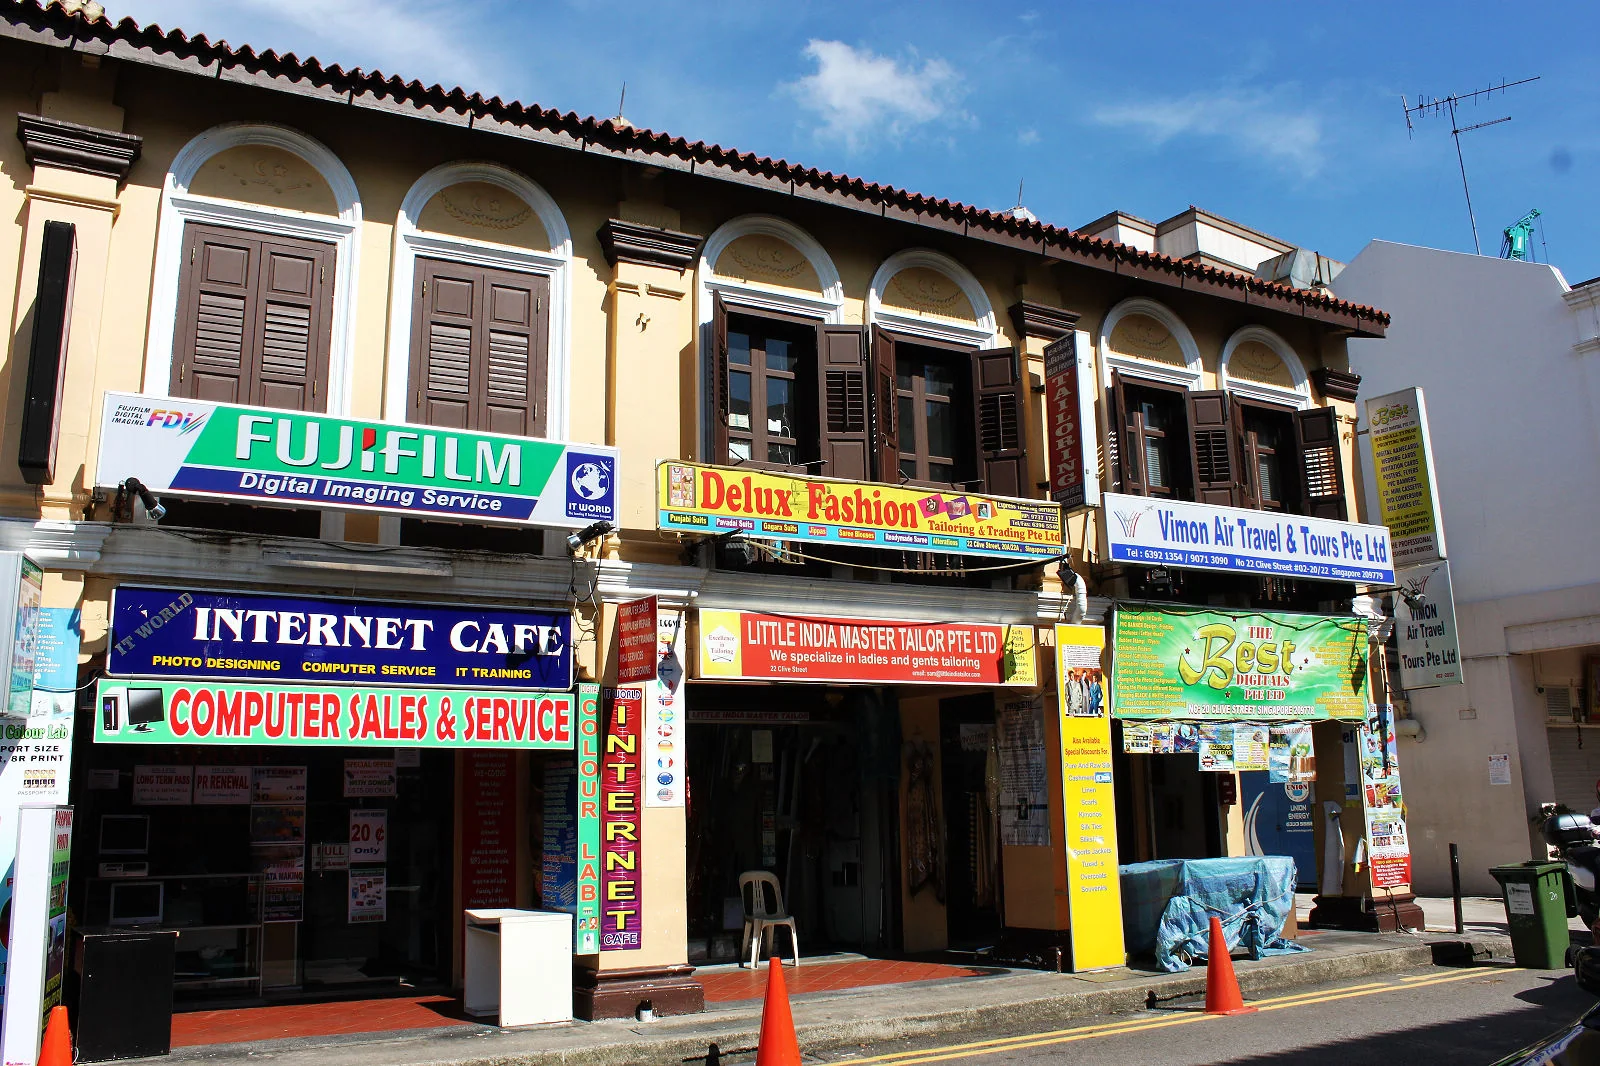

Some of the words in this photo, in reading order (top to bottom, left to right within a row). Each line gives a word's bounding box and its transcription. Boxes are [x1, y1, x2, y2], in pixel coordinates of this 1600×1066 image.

[115, 411, 142, 419] DIGITAL
[118, 404, 151, 413] FUJIFILM
[112, 418, 144, 426] IMAGING
[146, 408, 194, 428] FDi
[1052, 371, 1077, 487] TAILORING
[235, 414, 522, 487] FUJIFILM
[1402, 451, 1416, 459] CARDS
[1381, 463, 1403, 472] INVITATION
[1404, 459, 1418, 467] CARDS
[1403, 467, 1418, 475] FLYERS
[1397, 476, 1416, 485] BANNERS
[240, 472, 319, 497] Digital
[322, 479, 414, 505] Imaging
[421, 489, 502, 512] Service
[700, 470, 792, 516] Delux
[806, 481, 918, 528] Fashion
[578, 504, 612, 514] WORLD
[670, 514, 692, 524] Punjabi
[692, 516, 707, 524] Suits
[716, 518, 738, 527] Pavadai
[738, 520, 753, 528] Suits
[763, 522, 782, 532] Gagara
[784, 524, 798, 532] Suits
[928, 520, 974, 536] Tailoring
[979, 526, 985, 536] &
[986, 526, 1025, 542] Trading
[1028, 529, 1042, 540] Pte
[1045, 531, 1060, 542] Ltd
[885, 534, 912, 542] Readymade
[933, 537, 958, 546] Alterations
[1158, 510, 1209, 544] Vimon
[1214, 517, 1234, 548] Air
[1237, 518, 1281, 552] Travel
[1286, 524, 1297, 554] &
[1300, 526, 1338, 559] Tours
[1341, 530, 1363, 560] Pte
[1366, 533, 1388, 563] Ltd
[1399, 536, 1432, 547] PROFESSIONAL
[1025, 546, 1046, 554] Singapore
[1126, 548, 1139, 558] Tel
[1144, 550, 1163, 560] 6392
[1164, 552, 1183, 562] 1354
[1190, 553, 1209, 564] 9071
[1210, 555, 1229, 565] 3090
[1236, 558, 1244, 567] No
[1245, 559, 1254, 567] 22
[1256, 560, 1271, 569] Clive
[1273, 562, 1293, 571] Street
[1294, 564, 1329, 575] #02-20/22
[1331, 567, 1361, 579] Singapore
[1362, 569, 1384, 579] 209779
[137, 591, 194, 642] WORLD
[193, 606, 434, 654] INTERNET
[449, 620, 564, 658] CAFE
[747, 620, 796, 646] LITTLE
[800, 623, 836, 649] INDIA
[840, 625, 894, 651] MASTER
[898, 627, 945, 652] TAILOR
[948, 629, 971, 653] PTE
[975, 631, 997, 654] LTD
[1248, 626, 1272, 639] THE
[1407, 625, 1418, 640] Air
[1420, 621, 1445, 638] Travel
[770, 649, 787, 661] We
[790, 652, 843, 667] specialize
[846, 653, 855, 664] in
[858, 653, 888, 666] ladies
[890, 654, 909, 666] and
[912, 656, 939, 669] gents
[941, 656, 980, 670] tailoring
[1178, 622, 1296, 690] Best
[1402, 654, 1425, 669] Tours
[1426, 652, 1440, 666] Pte
[1442, 649, 1456, 664] Ltd
[152, 656, 202, 670] PHOTO
[206, 658, 280, 672] DESIGNING
[302, 661, 376, 675] COMPUTER
[380, 665, 436, 677] SERVICE
[456, 667, 468, 678] IT
[471, 668, 532, 680] TRAINING
[1236, 674, 1290, 686] DIGITALS
[581, 686, 599, 694] DIGITAL
[604, 689, 611, 698] IT
[614, 689, 641, 700] WORLD
[1244, 690, 1264, 700] PTE
[1267, 690, 1286, 700] LTD
[168, 688, 340, 740] COMPUTER
[348, 692, 429, 742] SALES
[436, 696, 459, 741] &
[462, 694, 570, 743] SERVICE
[1211, 704, 1230, 715] CLIVE
[1231, 705, 1256, 715] STREET
[1257, 706, 1293, 715] SINGAPORE
[6, 724, 45, 740] Colour
[47, 724, 68, 739] Lab
[581, 699, 598, 818] COLOUR
[1065, 748, 1080, 756] Special
[1081, 748, 1100, 756] Discounts
[136, 776, 154, 784] LONG
[156, 776, 172, 784] TERM
[174, 776, 190, 785] PASS
[197, 776, 208, 789] PR
[210, 776, 249, 790] RENEWAL
[606, 705, 638, 930] INTERNET
[352, 824, 370, 841] 20
[354, 847, 380, 855] Only
[580, 843, 597, 902] LAB
[604, 932, 638, 945] CAFE
